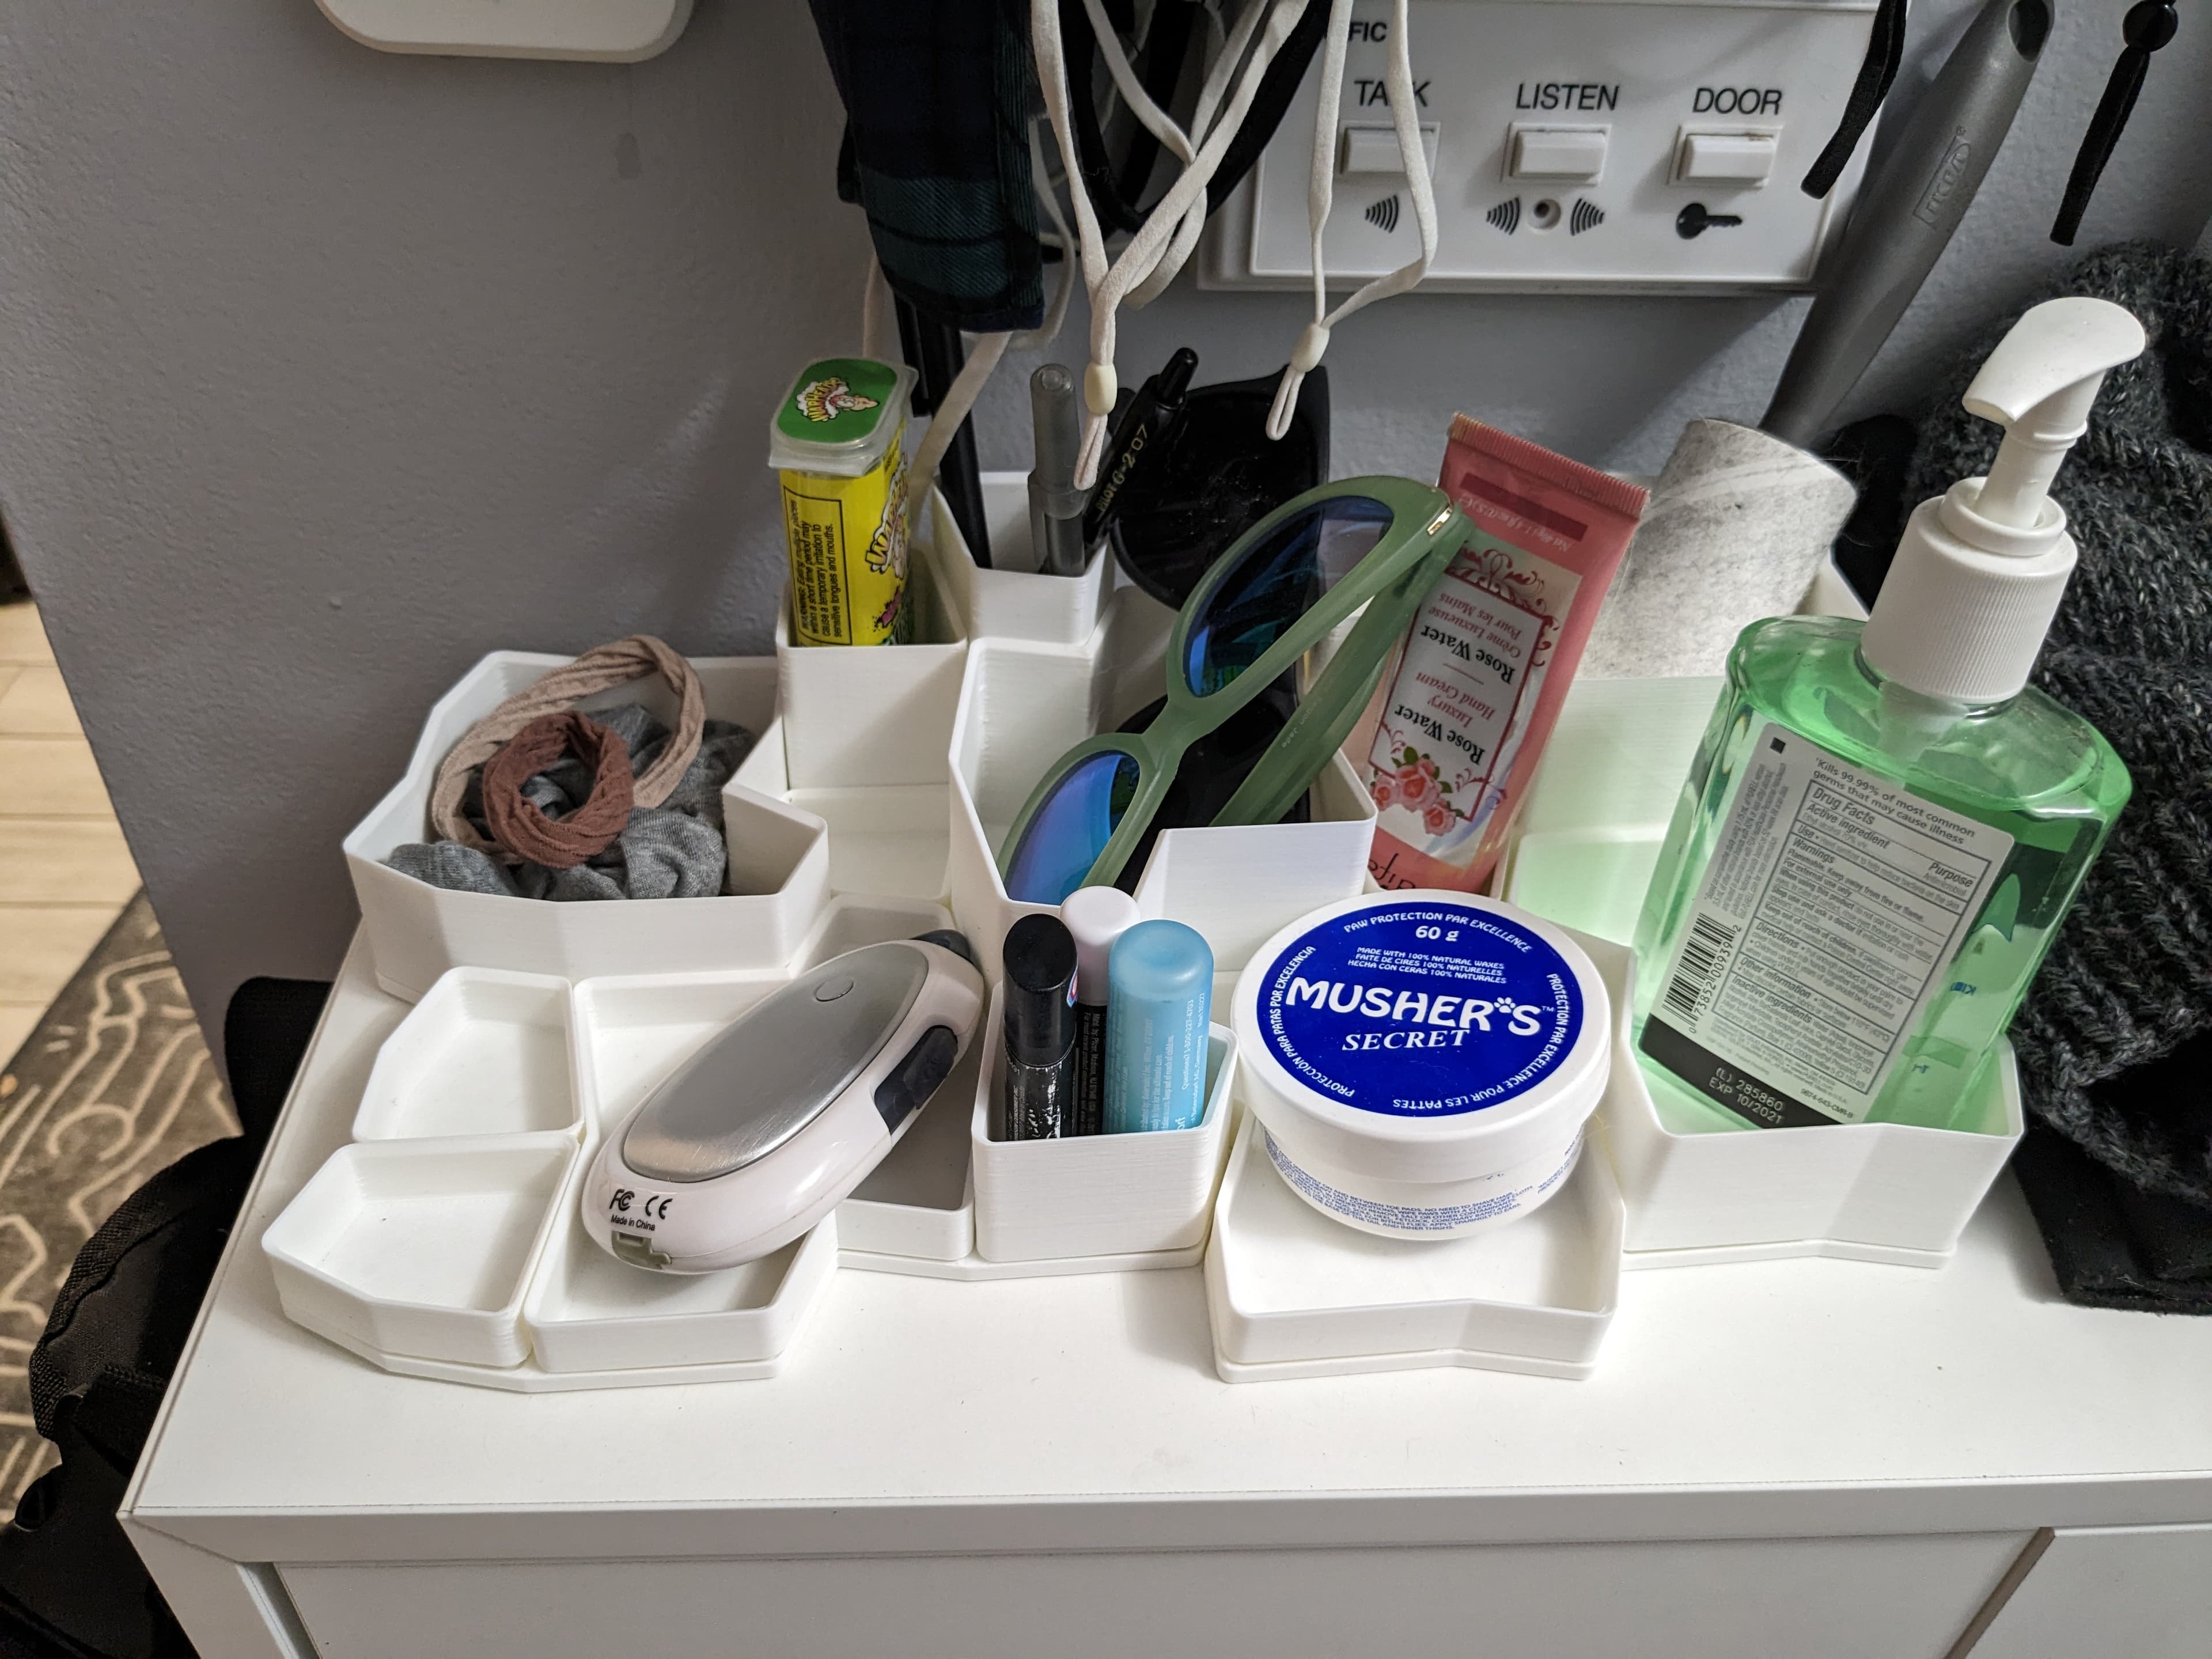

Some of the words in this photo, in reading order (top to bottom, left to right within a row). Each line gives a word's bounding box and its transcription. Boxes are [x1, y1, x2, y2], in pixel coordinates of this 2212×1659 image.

[1354, 79, 1431, 108] TAK
[1517, 83, 1619, 111] LISTEN
[1692, 87, 1783, 115] DOOR
[823, 524, 835, 555] mouths.
[827, 556, 836, 571] and
[829, 573, 840, 604] tongues
[1438, 593, 1476, 616] Mains
[1476, 610, 1494, 626] les
[1427, 603, 1486, 639] Luxueuse
[1494, 620, 1522, 641] Pour
[1420, 625, 1470, 661] Water
[1475, 649, 1516, 684] Rose
[1416, 672, 1459, 699] Cream
[1427, 695, 1474, 728] Luxury
[1459, 693, 1495, 720] Hand
[1394, 704, 1442, 741] Water
[1446, 730, 1485, 765] Rose
[1812, 787, 1842, 810] Drug
[1842, 802, 1875, 825] Facts
[1813, 770, 1845, 790] germs
[1847, 786, 1869, 802] that
[1871, 799, 1895, 815] may
[1896, 811, 1927, 828] cause
[1929, 824, 1964, 844] illness
[1841, 771, 1878, 796] 99.99%
[1882, 793, 1896, 802] of
[1895, 800, 1924, 816] most
[1926, 813, 1975, 838] common
[1798, 824, 1815, 838] Use
[1792, 837, 1835, 863] Warnings
[1806, 803, 1838, 823] Active
[1838, 818, 1891, 849] ingredient
[1928, 862, 1973, 887] Purpose
[1344, 920, 1368, 933] PAW
[1370, 912, 1442, 925] PROTECTION
[1445, 914, 1468, 925] PAR
[1469, 919, 1533, 953] EXCELLENCE
[1415, 926, 1440, 940] 60
[1445, 931, 1459, 942] g
[1755, 922, 1800, 948] Directions
[1355, 953, 1379, 961] FAITE
[1395, 957, 1420, 965] CIRES
[1446, 964, 1502, 976] NATURELLES
[1357, 947, 1381, 955] MADE
[1431, 956, 1472, 965] NATURAL
[1474, 960, 1505, 969] WAXES
[1711, 939, 1733, 979] 00939
[1733, 925, 1741, 933] 2
[1275, 945, 1316, 993] EXCELENCIA
[1347, 959, 1377, 968] HECHA
[1399, 965, 1427, 974] CERAS
[1454, 971, 1506, 983] NATURALES
[1740, 957, 1763, 973] Other
[1764, 971, 1812, 999] information
[1270, 989, 1284, 1007] POR
[1547, 973, 1570, 1026] PROTECTION
[1732, 975, 1766, 998] Inactive
[1765, 995, 1812, 1023] ingredients
[1270, 1008, 1285, 1035] PATAS
[1549, 1027, 1570, 1043] PAR
[1277, 1035, 1298, 1058] PARA
[1342, 1029, 1471, 1051] SECRET
[1502, 1045, 1557, 1088] EXCELLENCE
[1445, 1096, 1470, 1107] LES
[1470, 1084, 1505, 1101] POUR
[1709, 1077, 1732, 1093] EXP
[1737, 1093, 1782, 1123] 10/2021
[1715, 1067, 1732, 1082] (L)
[1736, 1080, 1783, 1111] 285860
[1393, 1099, 1442, 1109] PATTES
[645, 1195, 673, 1219] CE
[1350, 1195, 1384, 1207] BETWEEN
[1472, 1198, 1495, 1207] SHAVE
[1469, 1203, 1493, 1211] CLEAN
[610, 1214, 628, 1226] Made
[628, 1217, 635, 1226] in
[636, 1219, 656, 1231] China
